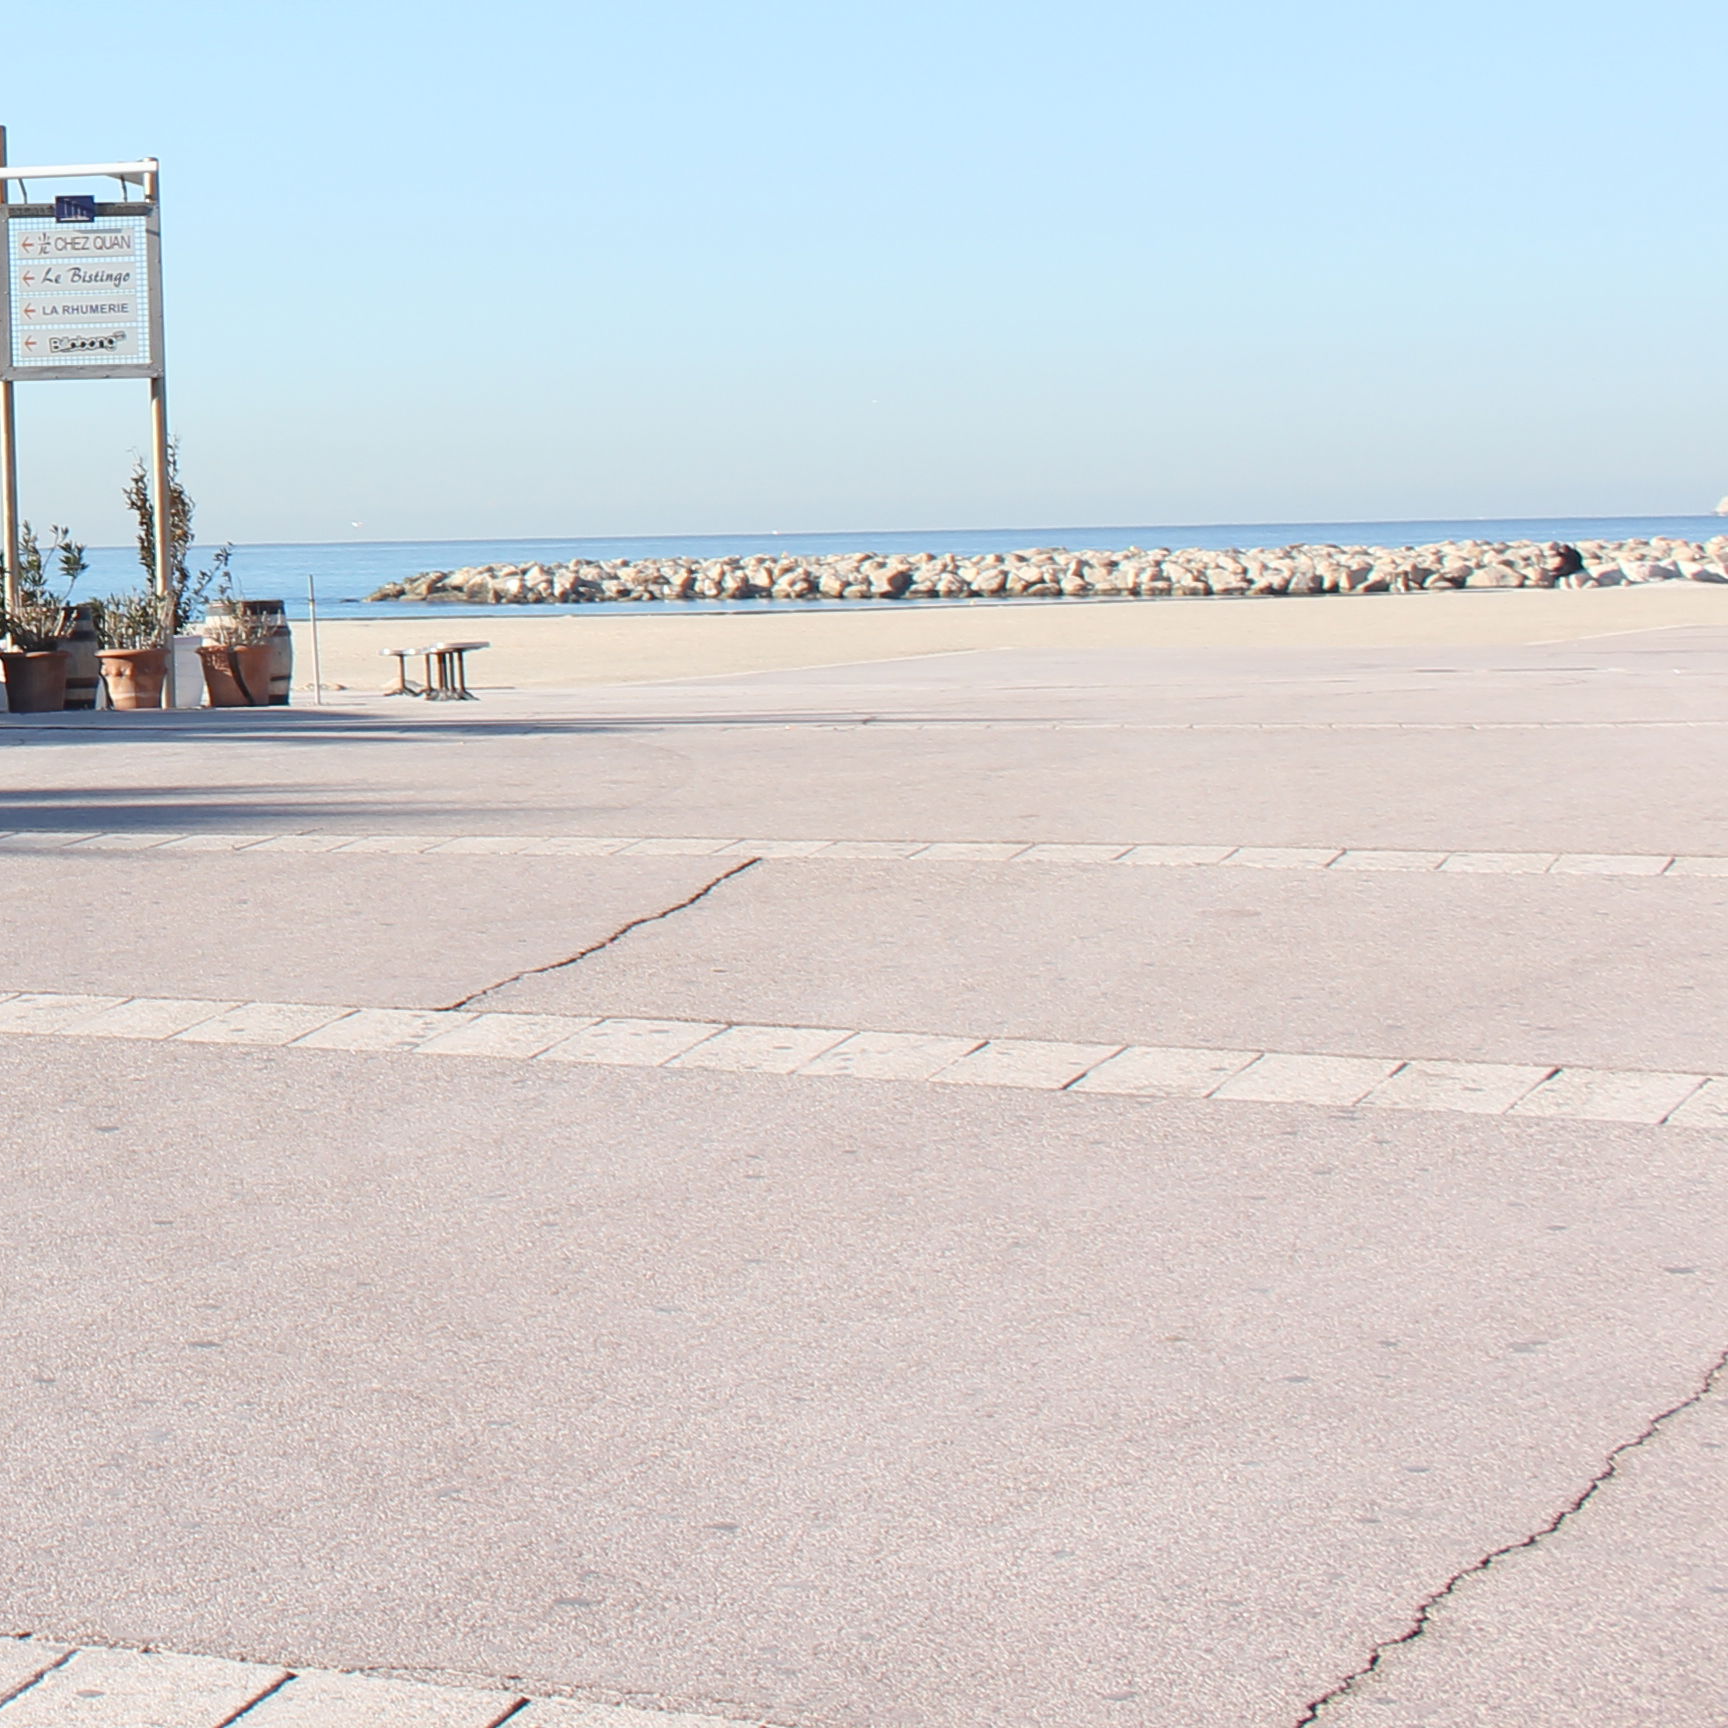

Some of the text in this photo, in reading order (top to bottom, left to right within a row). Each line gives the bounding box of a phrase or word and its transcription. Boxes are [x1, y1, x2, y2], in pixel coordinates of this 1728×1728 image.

[54, 234, 132, 252] CHEZ QUAN
[40, 266, 131, 288] Le Bistingo
[41, 302, 130, 316] LA RHUMERIE
